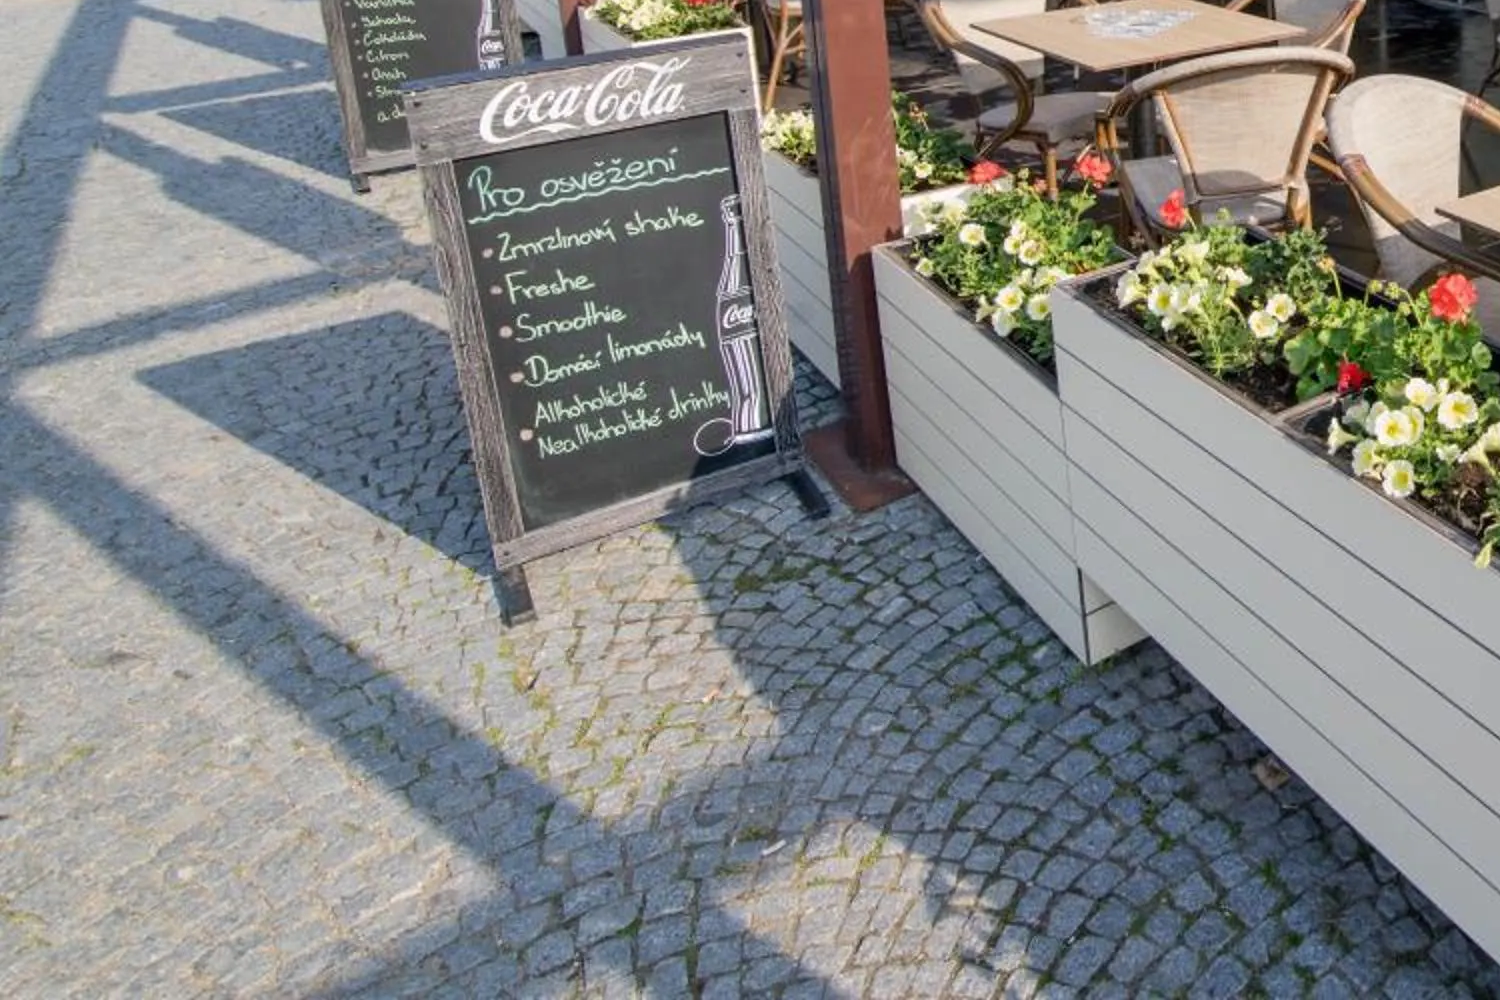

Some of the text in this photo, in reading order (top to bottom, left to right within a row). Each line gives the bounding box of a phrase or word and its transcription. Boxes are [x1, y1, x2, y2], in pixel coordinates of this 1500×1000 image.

[479, 57, 691, 144] Coca-Cola
[468, 166, 525, 212] Pro
[497, 206, 705, 261] Zmrzlinový shake
[505, 269, 596, 304] Freshe
[515, 301, 627, 343] Smoothie
[523, 322, 706, 387] Domácí limonády
[668, 380, 731, 420] drinky
